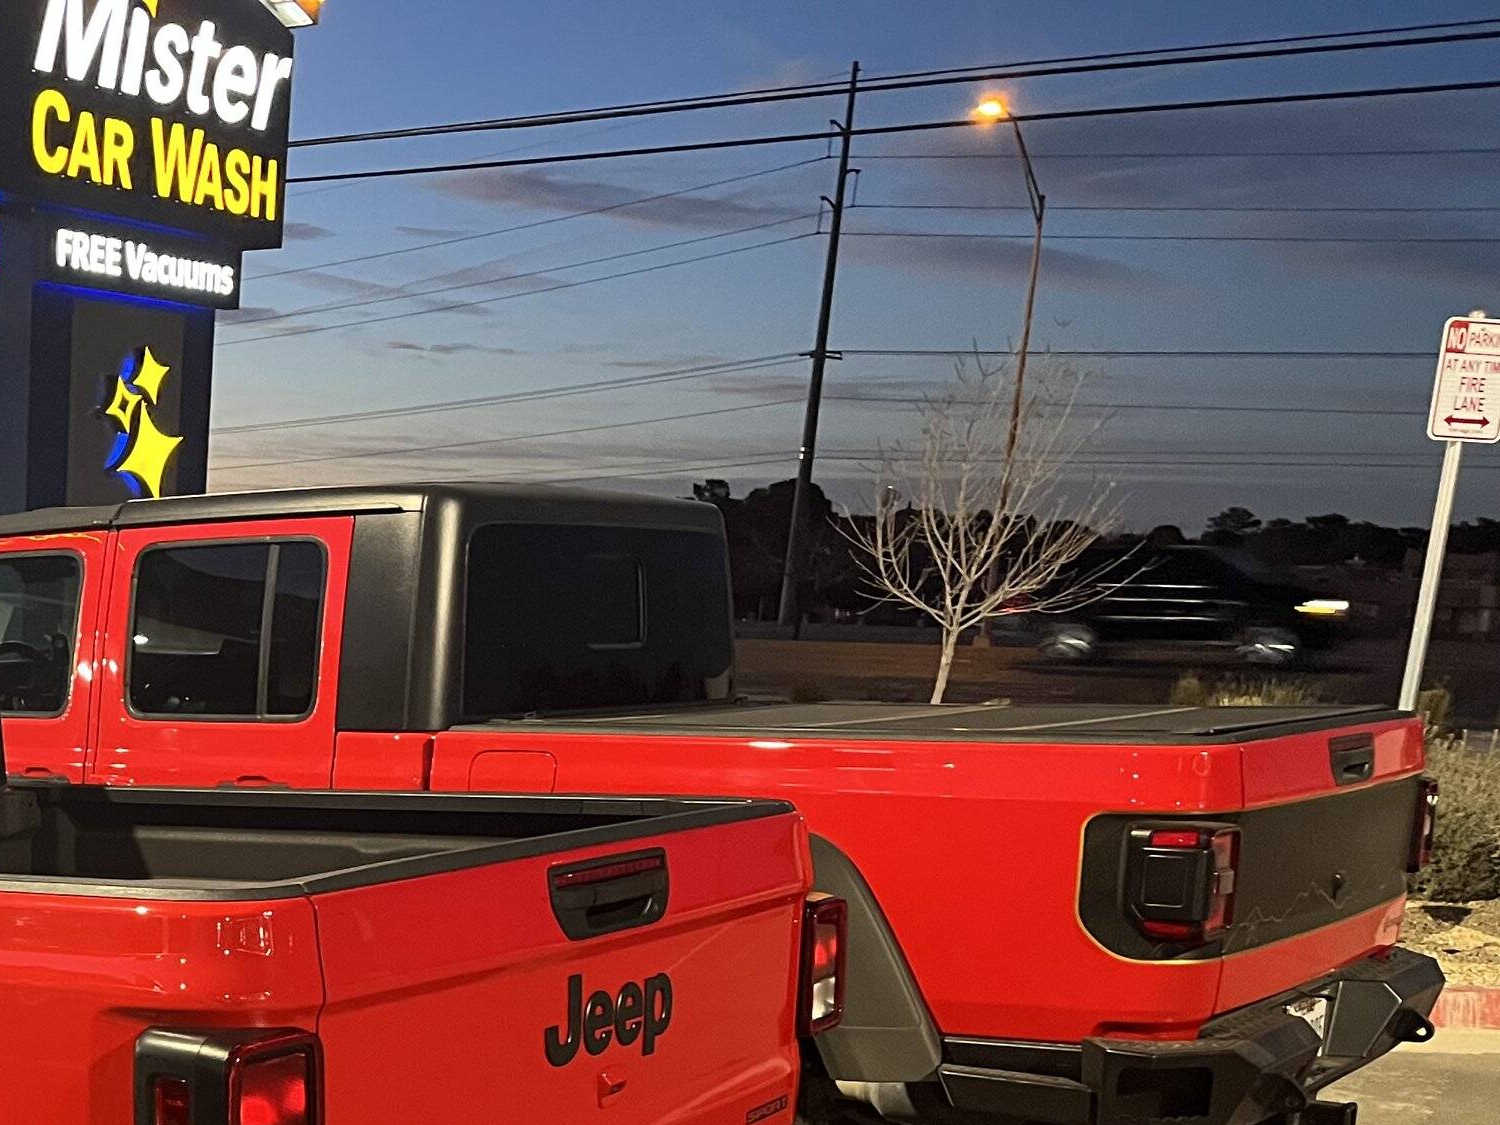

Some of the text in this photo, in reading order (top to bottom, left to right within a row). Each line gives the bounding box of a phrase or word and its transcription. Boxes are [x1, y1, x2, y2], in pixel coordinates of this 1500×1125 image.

[34, 0, 293, 131] Mister
[32, 89, 278, 221] CAR WASH
[55, 228, 235, 296] FREE Vacuums
[1447, 327, 1467, 350] NO
[1446, 359, 1459, 370] AT
[1460, 360, 1481, 373] ANY
[1460, 376, 1486, 393] FIRE
[1453, 396, 1486, 413] LANE
[544, 973, 673, 1067] Jeep
[746, 1095, 788, 1125] SPORT
